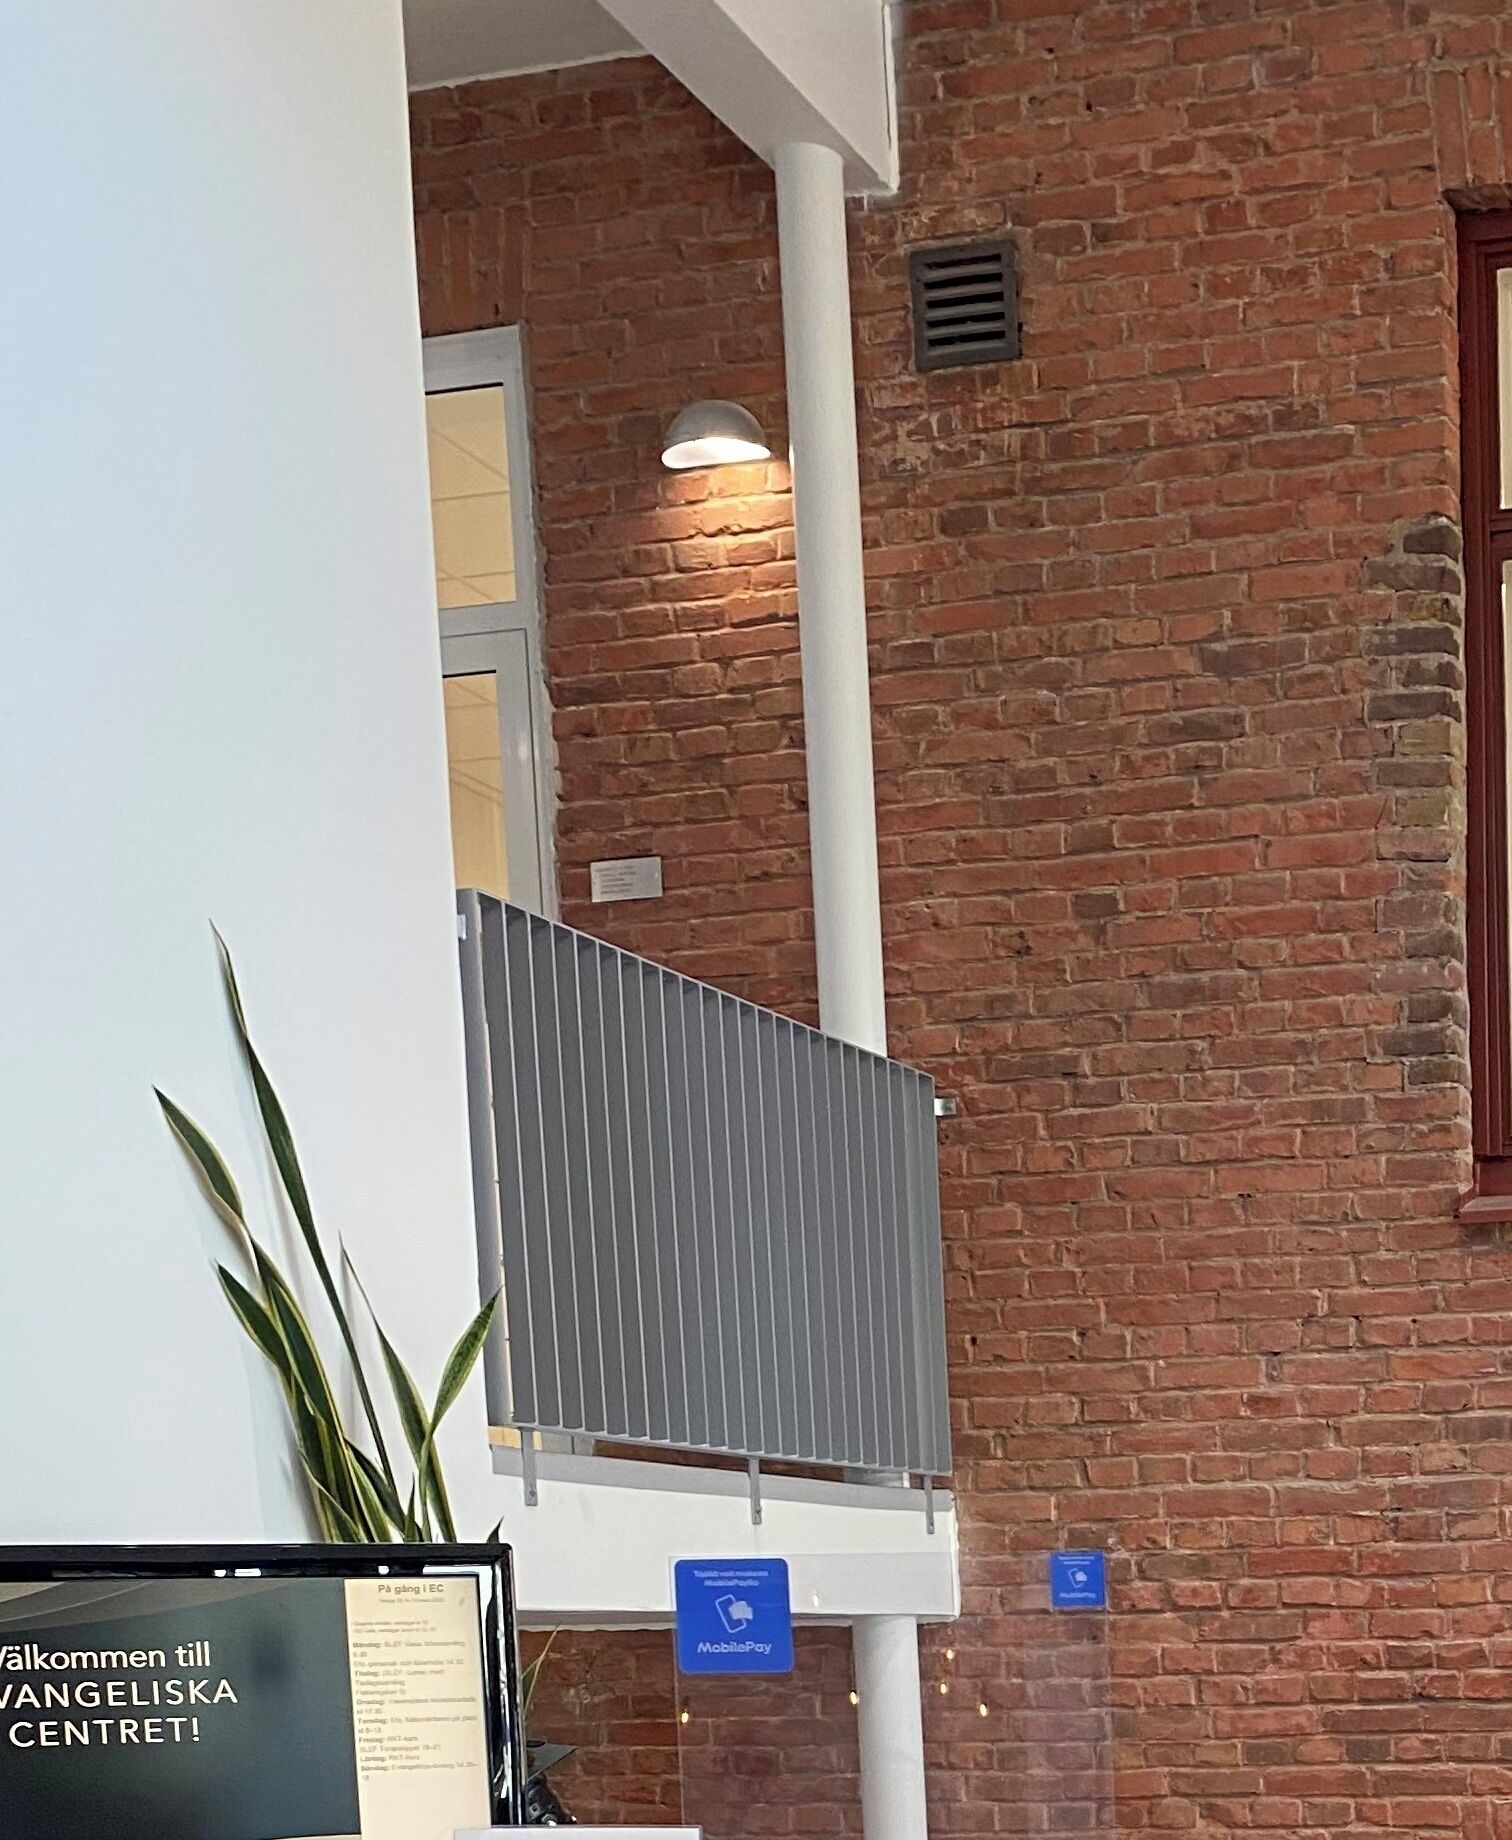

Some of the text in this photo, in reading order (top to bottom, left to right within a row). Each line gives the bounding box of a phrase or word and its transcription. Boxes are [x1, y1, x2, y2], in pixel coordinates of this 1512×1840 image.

[377, 1583, 391, 1594] På
[394, 1583, 420, 1595] gång
[429, 1583, 444, 1593] EC
[175, 1640, 210, 1668] till
[697, 1641, 772, 1655] MobilePay
[8, 1716, 201, 1748] CENTRET!
